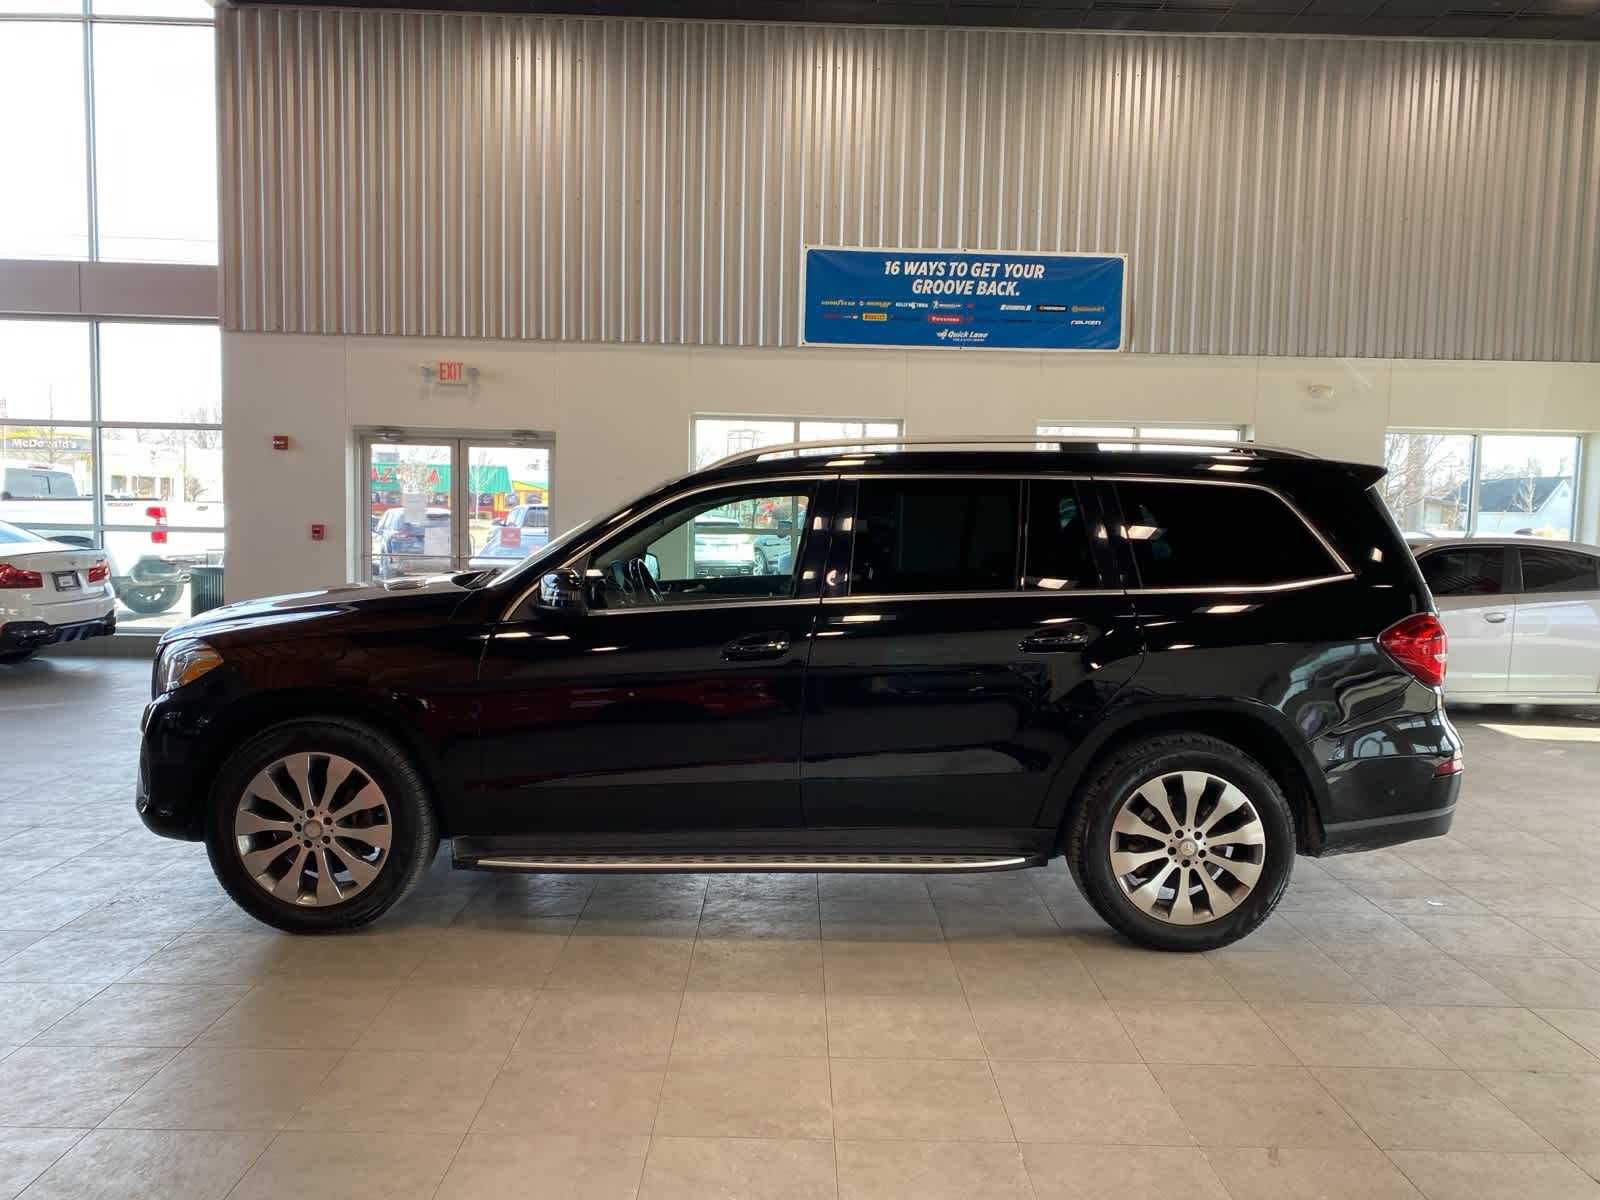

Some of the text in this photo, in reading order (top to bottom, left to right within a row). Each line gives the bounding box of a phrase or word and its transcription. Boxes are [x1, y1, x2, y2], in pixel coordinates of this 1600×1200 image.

[884, 261, 1045, 279] 16 WAYS TO GET YOUR
[912, 279, 1020, 297] GROOVE BACK.
[947, 330, 989, 339] Quick Lane
[439, 361, 465, 380] EXIT
[12, 438, 77, 449] McDoald's
